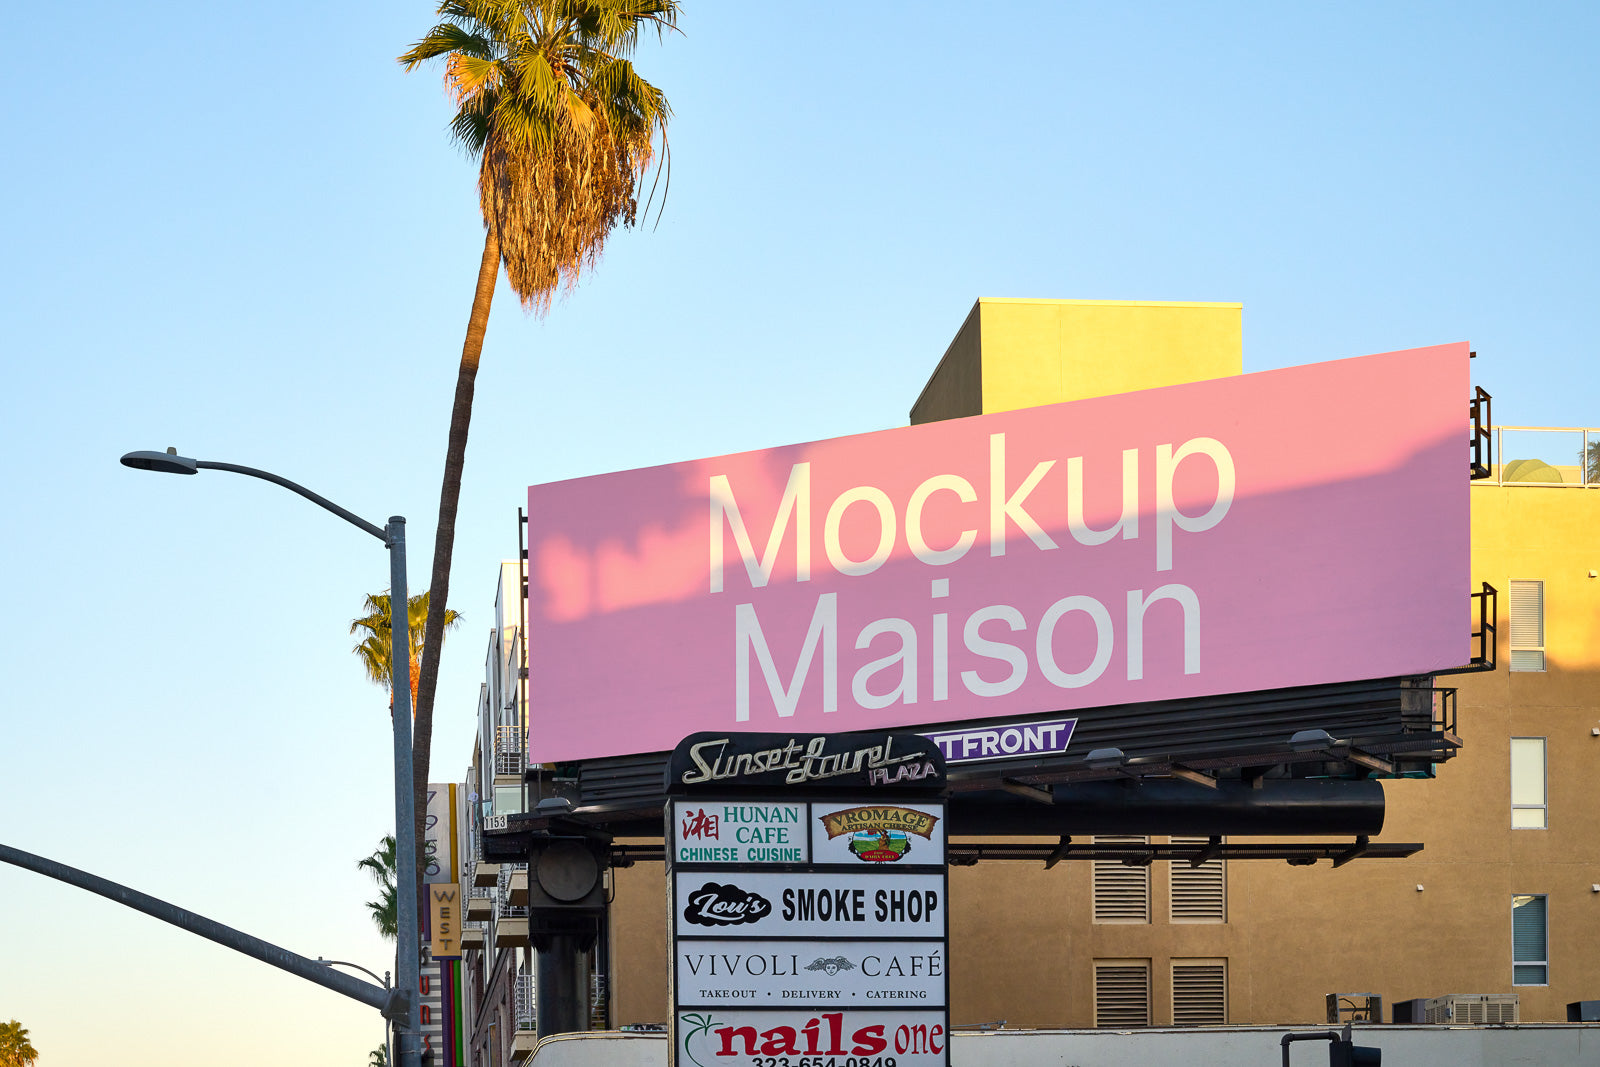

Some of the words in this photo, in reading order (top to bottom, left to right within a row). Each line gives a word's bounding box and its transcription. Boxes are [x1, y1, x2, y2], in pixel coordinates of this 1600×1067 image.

[710, 432, 1236, 594] Mockup
[736, 578, 1201, 723] Maison
[934, 723, 1066, 759] TFRONT
[682, 738, 804, 784] Sunset
[786, 735, 926, 785] Laurel
[868, 761, 939, 786] PLAZA
[485, 816, 506, 829] 1153
[723, 806, 799, 824] HUNAN
[831, 809, 929, 828] VROMAGE
[841, 822, 881, 832] ARTISAN
[882, 822, 919, 832] CHEESE
[735, 826, 790, 844] CAFE
[680, 847, 738, 861] CHINESE
[747, 847, 801, 862] CUISINE
[693, 893, 768, 922] Lou's
[782, 888, 866, 922] SMOKE
[874, 889, 938, 923] SHOP
[434, 890, 456, 951] WEST
[684, 954, 800, 976] VIVOLI
[861, 950, 943, 977] CAFÉ
[782, 990, 842, 999] DELIVERY
[866, 990, 928, 999] CATERING
[714, 1012, 888, 1057] nails
[894, 1023, 944, 1055] one
